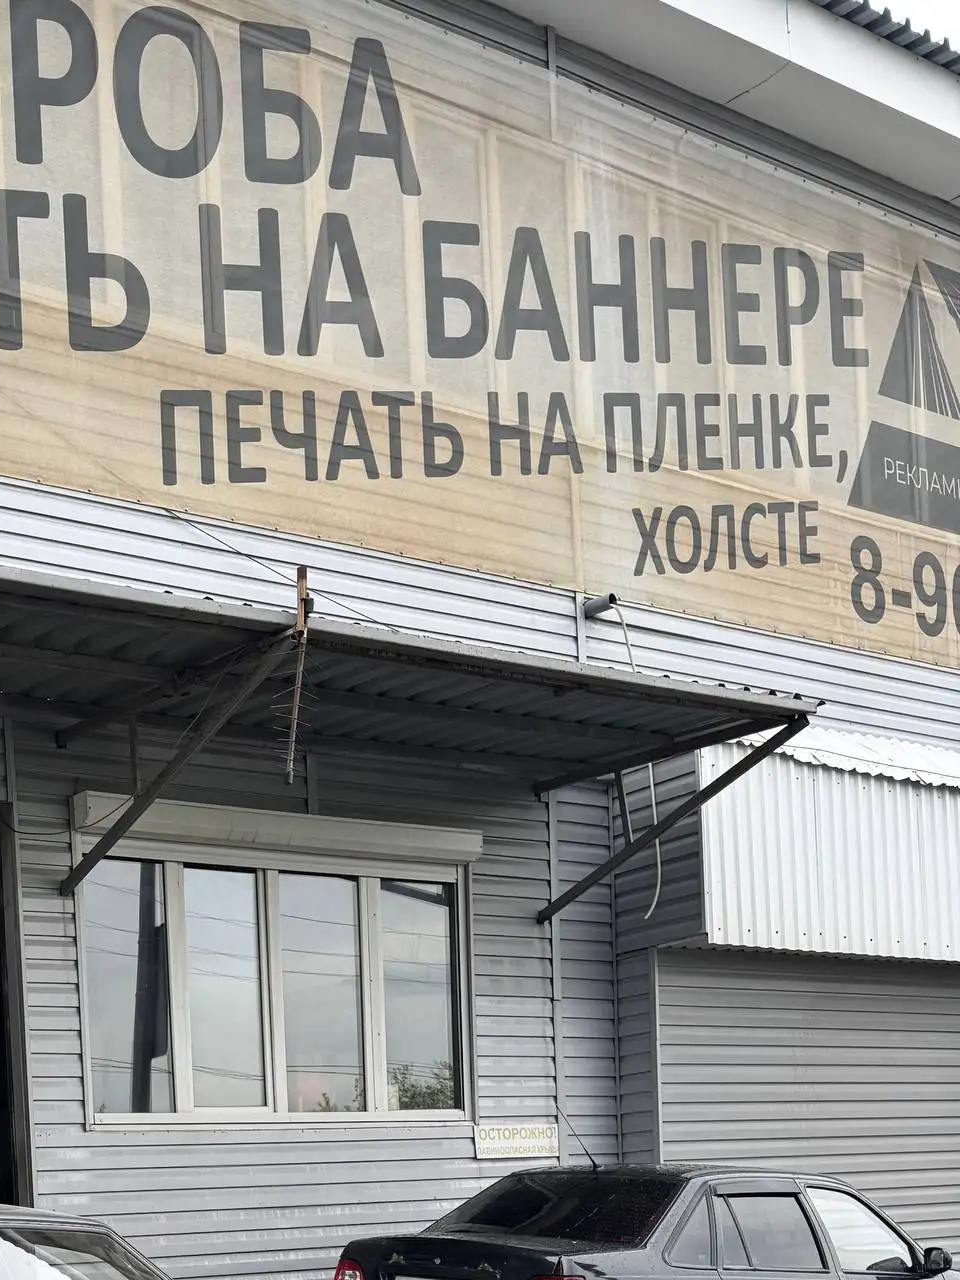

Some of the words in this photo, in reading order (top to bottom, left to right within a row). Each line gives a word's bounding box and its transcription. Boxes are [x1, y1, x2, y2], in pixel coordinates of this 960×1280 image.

[198, 203, 384, 358] НА
[422, 220, 869, 367] БАННЕРЕ
[160, 390, 464, 486] ПЕЧАТЬ
[487, 391, 583, 476] НА
[603, 393, 848, 483] ПЛЕНКЕ,
[632, 500, 821, 577] ХОЛСТЕ
[850, 535, 960, 637] 8-9
[479, 1126, 557, 1140] ОСТОРОЖНО!
